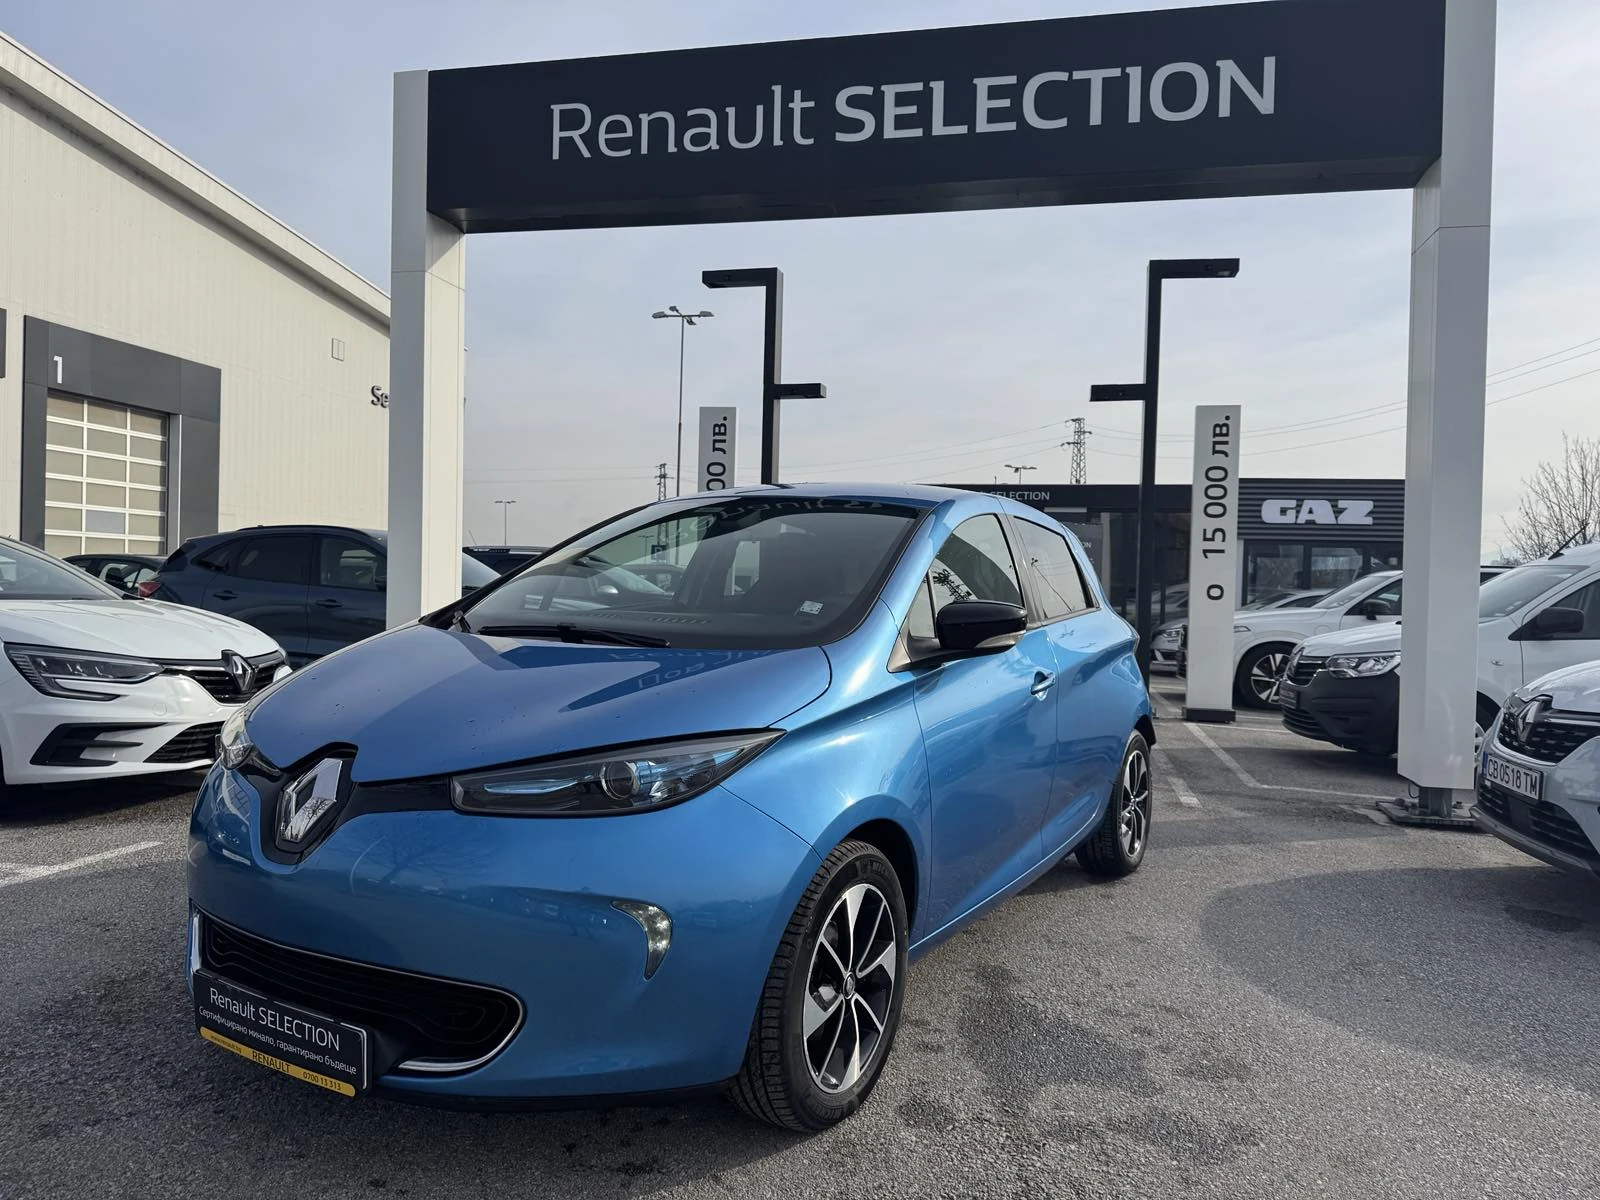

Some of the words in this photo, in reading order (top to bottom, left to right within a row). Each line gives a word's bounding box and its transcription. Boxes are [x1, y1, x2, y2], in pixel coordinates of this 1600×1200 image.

[551, 85, 815, 161] Renault
[835, 56, 1276, 143] SELECTION
[53, 355, 63, 384] 1
[712, 416, 728, 454] лв.
[1212, 415, 1231, 457] лв.
[1203, 465, 1229, 519] 000
[1261, 499, 1374, 525] GAZ
[1202, 528, 1226, 559] 15
[210, 987, 256, 1021] Renault
[258, 1007, 340, 1051] SELECTION
[199, 1006, 248, 1034] Сертифицирано
[276, 1039, 324, 1063] гарантирано
[324, 1055, 357, 1075] бъдеще
[252, 1050, 290, 1073] RENAULT
[303, 1071, 319, 1083] 0700
